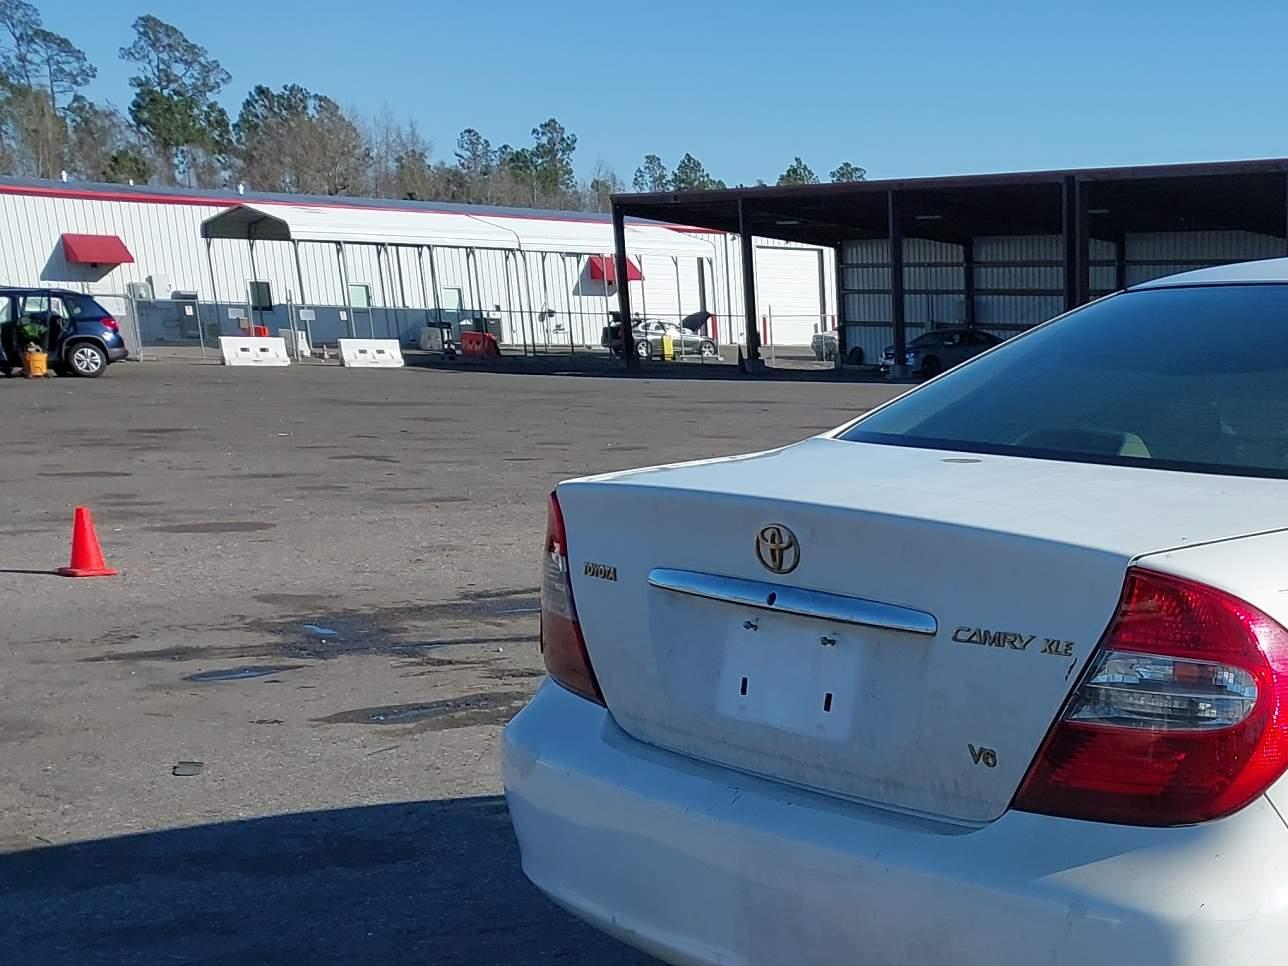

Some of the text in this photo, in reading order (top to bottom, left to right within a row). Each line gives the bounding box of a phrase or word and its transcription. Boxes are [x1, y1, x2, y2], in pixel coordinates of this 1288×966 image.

[584, 561, 617, 581] TOYOTA
[952, 626, 1074, 657] CAMRY XLE
[968, 744, 998, 769] V6
